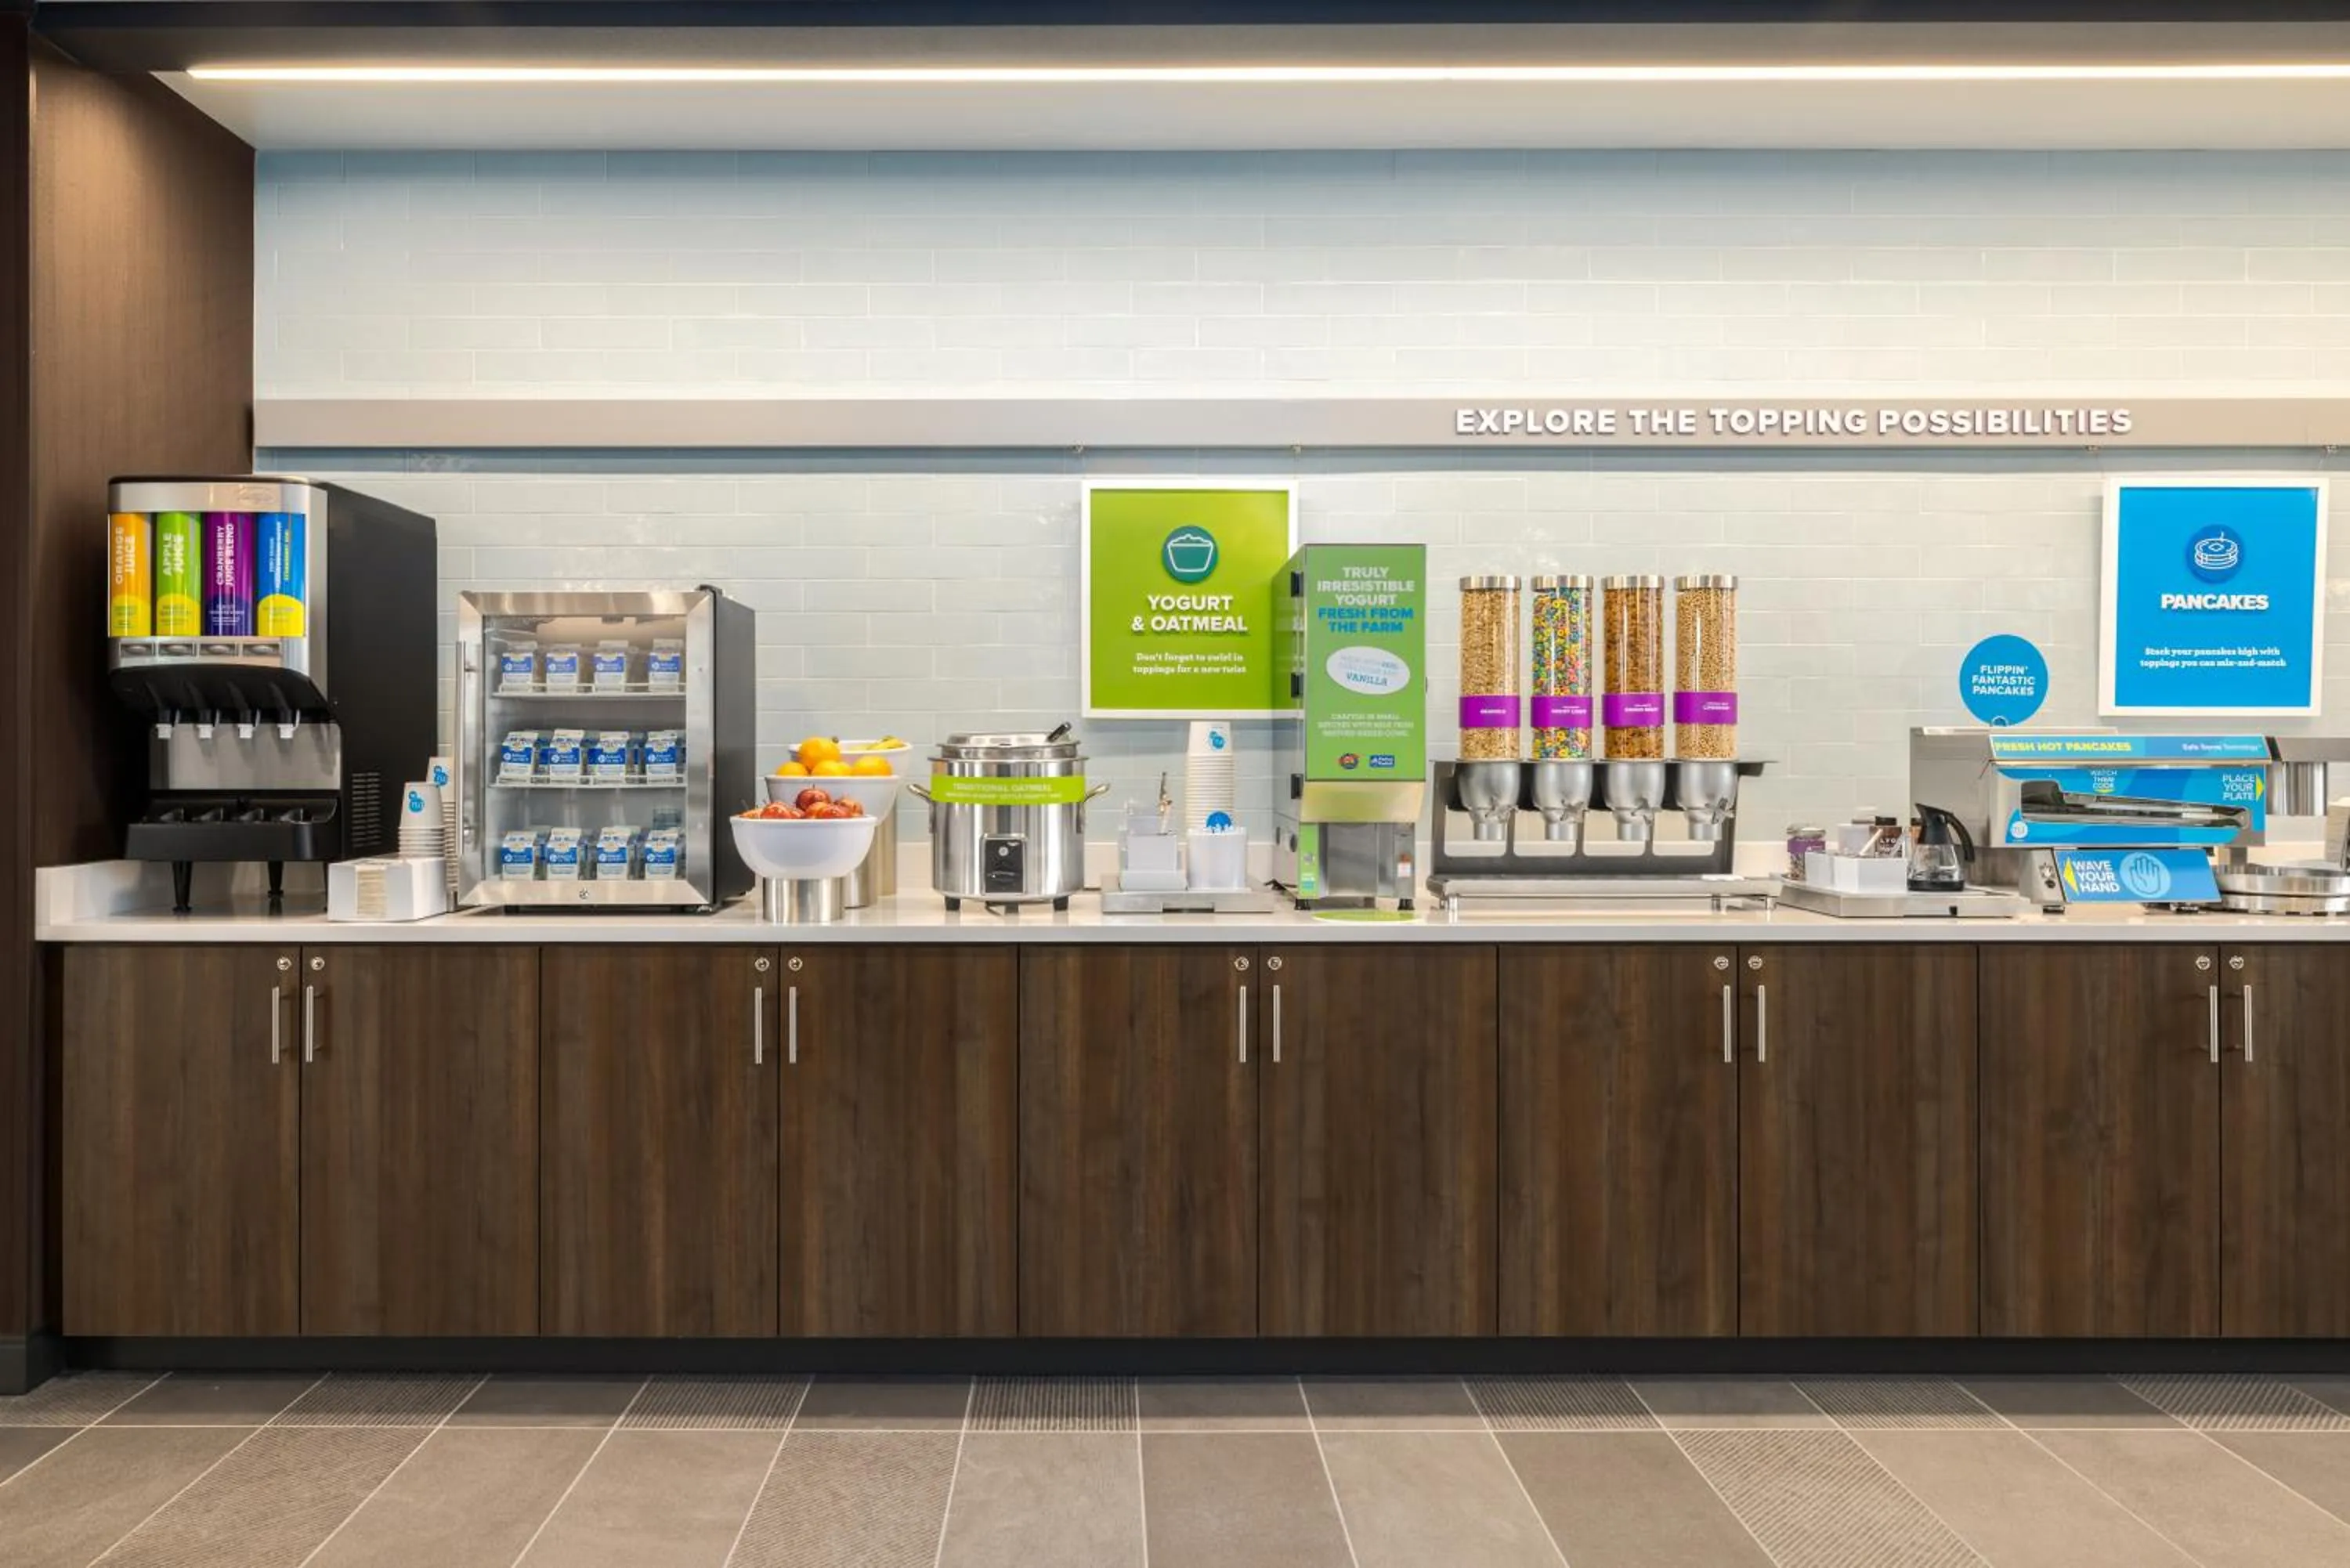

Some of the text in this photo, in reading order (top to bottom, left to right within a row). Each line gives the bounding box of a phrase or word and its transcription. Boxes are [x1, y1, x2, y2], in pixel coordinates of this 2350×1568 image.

[1455, 408, 2133, 435] EXPLORE THE TOPPING POSSIBILITIES
[115, 526, 125, 585] ORANGE
[125, 535, 136, 576] JUICE
[162, 532, 172, 576] APPLE
[173, 534, 185, 574] JUICE
[216, 525, 225, 586] CRANBERRY
[225, 522, 234, 587] JUICE BLEND
[1342, 567, 1390, 578] TRULY
[1317, 580, 1415, 591] IRRESISTIBLE
[1148, 595, 1234, 611] YOGURT
[1336, 594, 1397, 605] YOGURT
[2160, 593, 2269, 610] PANCAKES
[1318, 608, 1414, 620] FRESH FROM
[1132, 616, 1249, 631] & OATMEAL
[1329, 621, 1404, 633] THE FARM
[1136, 652, 1162, 661] Don't
[1165, 652, 1194, 663] forget
[1234, 652, 1244, 661] in
[2145, 647, 2170, 656] Stack
[2193, 647, 2236, 657] pancakes
[2238, 647, 2258, 657] high
[2259, 647, 2280, 656] with
[1133, 664, 1175, 675] toppings
[1177, 664, 1191, 673] for
[1980, 665, 2029, 674] FLIPPIN'
[2140, 659, 2179, 669] toppings
[1347, 672, 1387, 686] VANILLA
[1972, 675, 2036, 685] FANTASTIC
[1972, 685, 2034, 695] PANCAKES
[1994, 742, 2131, 751] FRESH HOT PANCAKES
[2222, 774, 2255, 782] PLACE
[2222, 792, 2254, 800] PLATE
[2074, 861, 2112, 871] WAVE
[2077, 872, 2115, 881] YOUR
[2080, 882, 2120, 893] HAND
